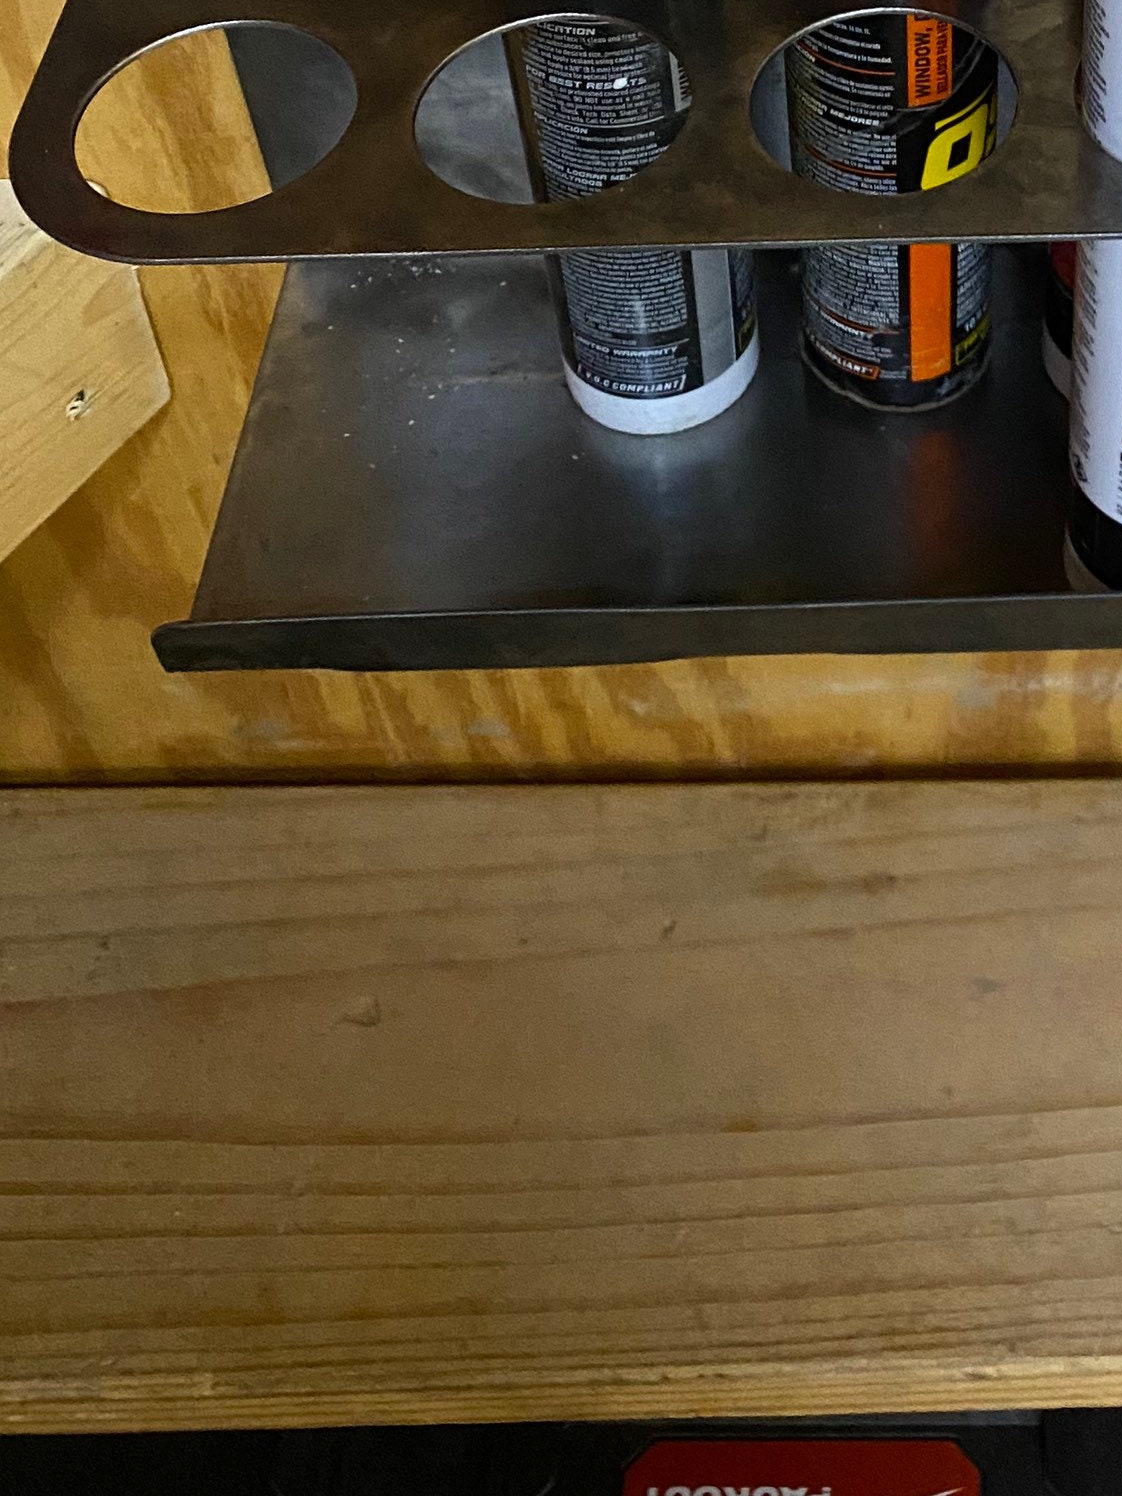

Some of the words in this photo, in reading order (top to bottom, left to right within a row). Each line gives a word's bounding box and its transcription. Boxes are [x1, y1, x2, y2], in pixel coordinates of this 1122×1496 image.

[914, 23, 932, 99] WINDOW,
[548, 75, 582, 88] BEST
[612, 345, 679, 357] WARRANTY
[611, 379, 680, 393] COMPLIANT
